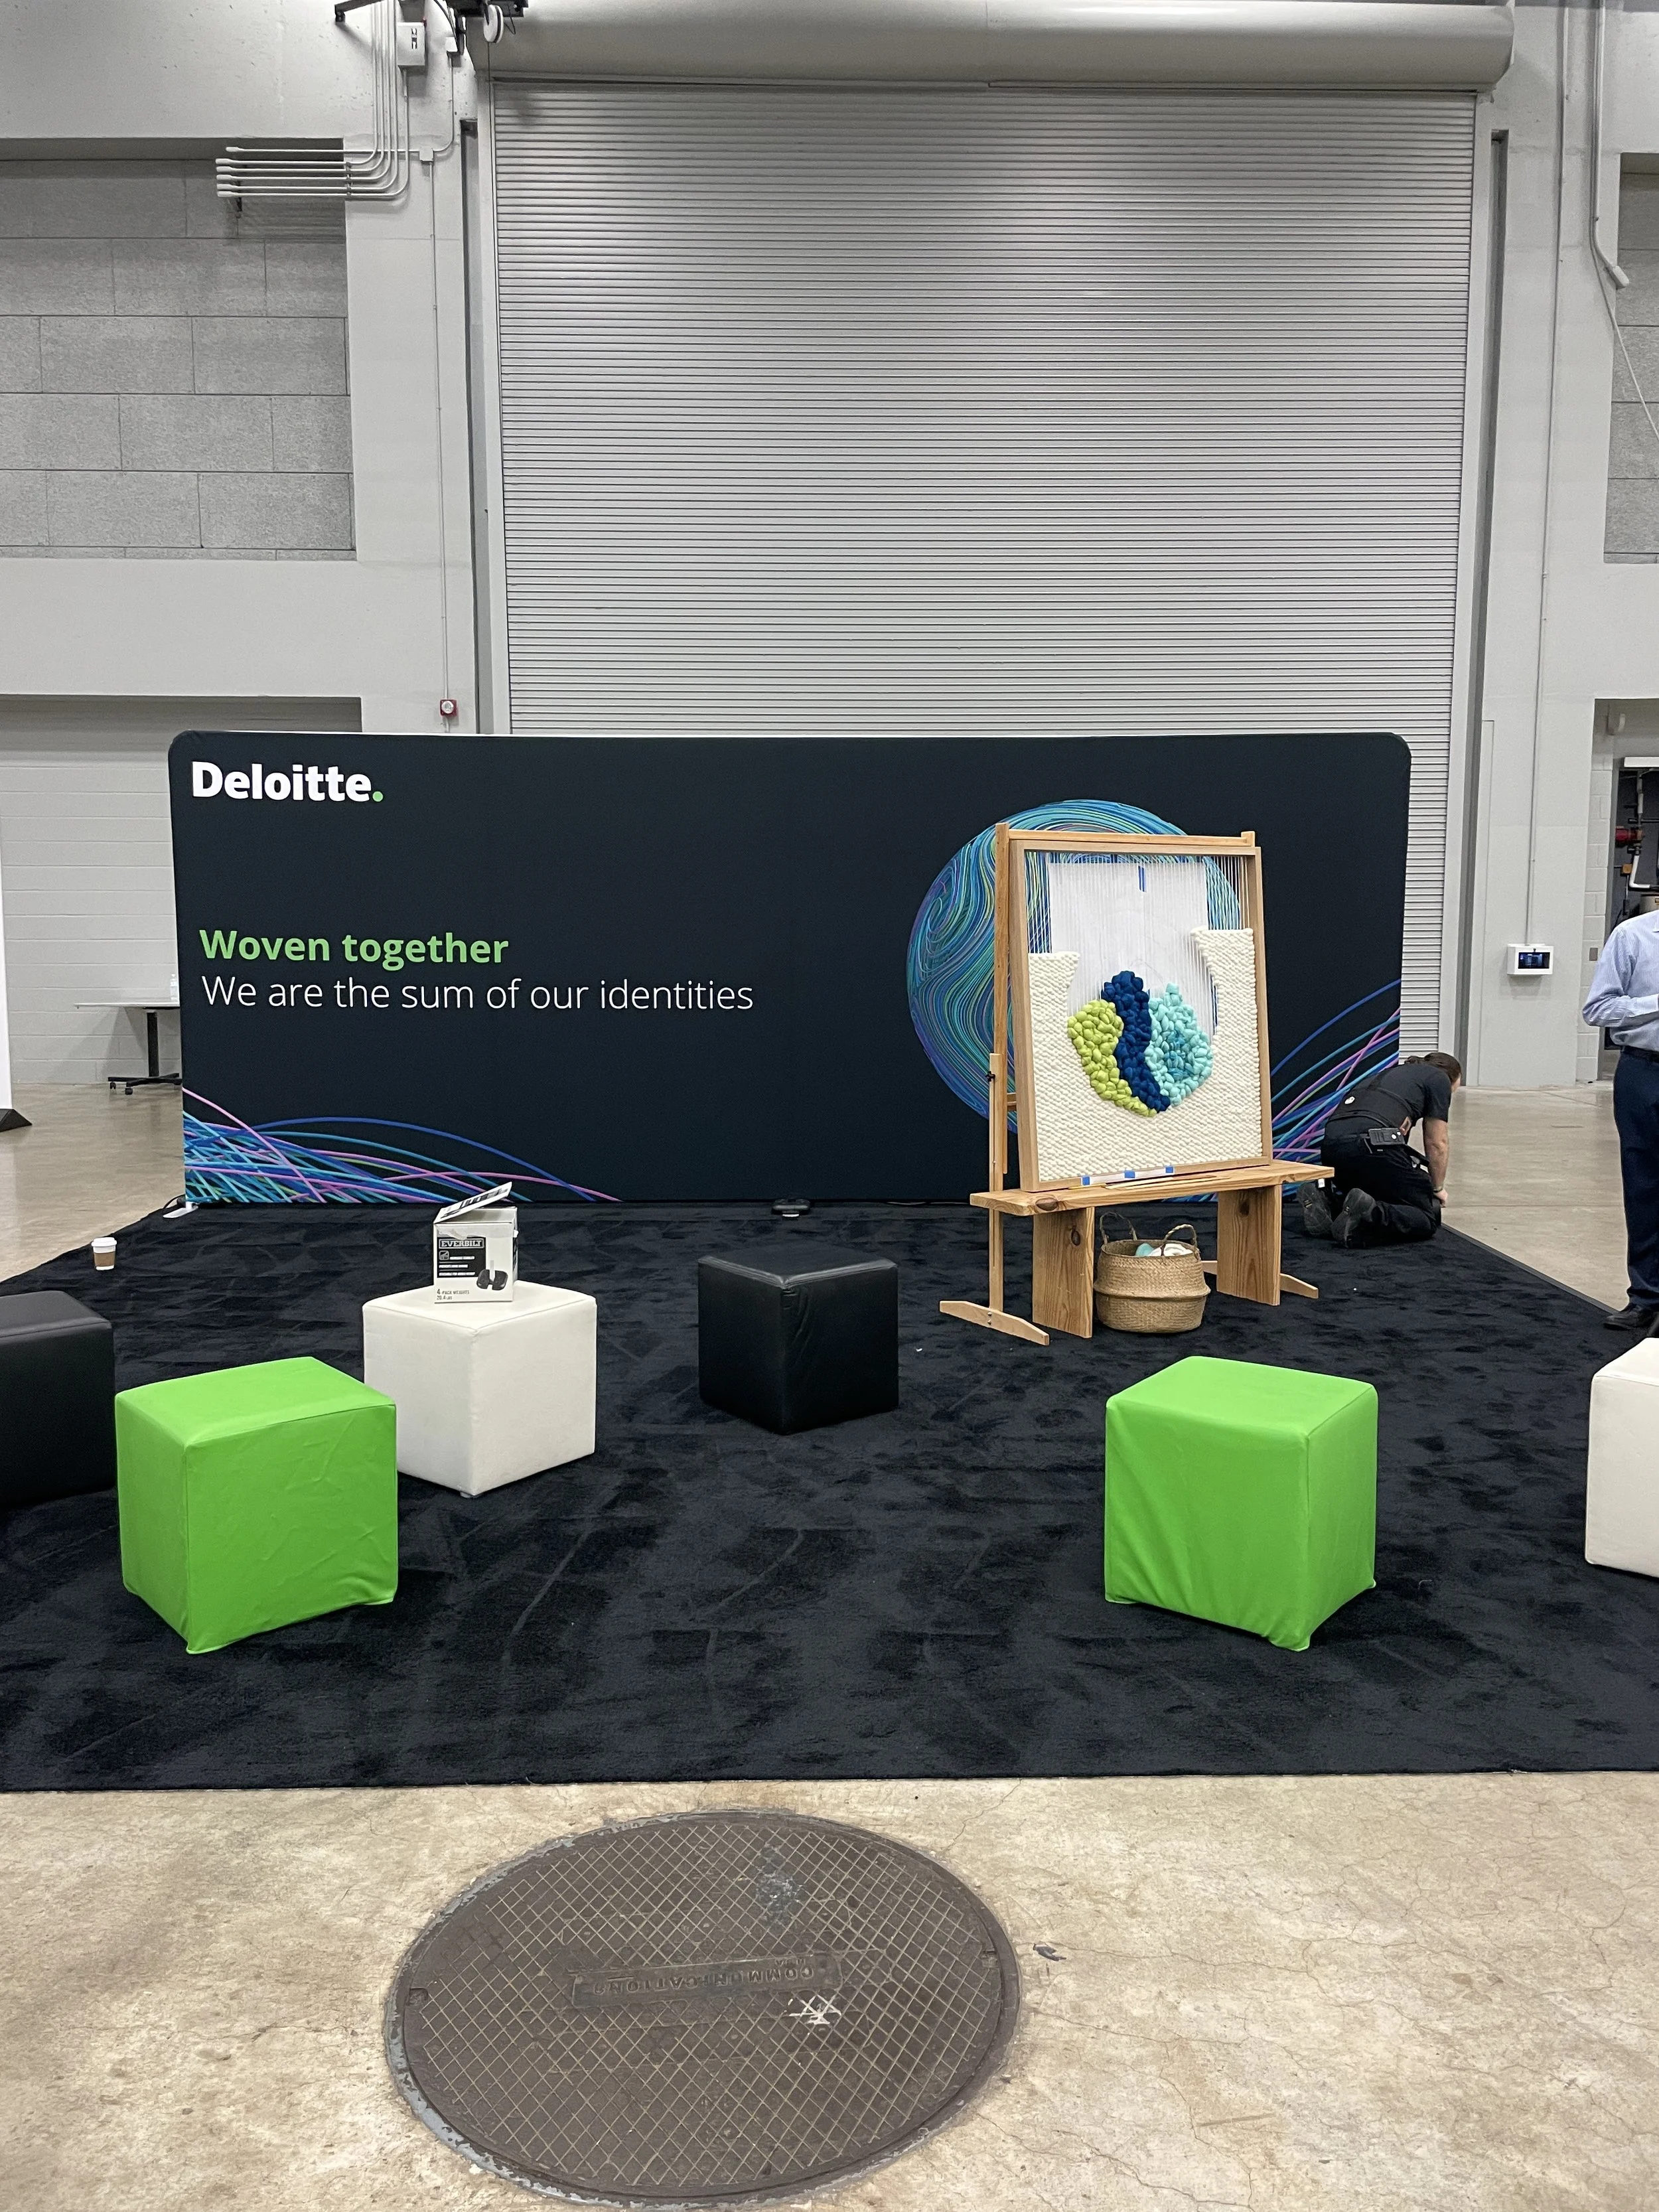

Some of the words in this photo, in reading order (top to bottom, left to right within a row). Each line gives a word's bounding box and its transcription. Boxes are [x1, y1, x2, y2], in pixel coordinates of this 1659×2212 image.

[192, 761, 384, 802] Deloitte.
[199, 929, 330, 961] Woven
[341, 932, 509, 971] together
[201, 976, 257, 1007] We
[268, 984, 323, 1007] are
[333, 976, 390, 1008] the
[401, 986, 474, 1009] sum
[486, 978, 522, 1009] of
[530, 986, 589, 1009] our
[601, 978, 754, 1010] identities
